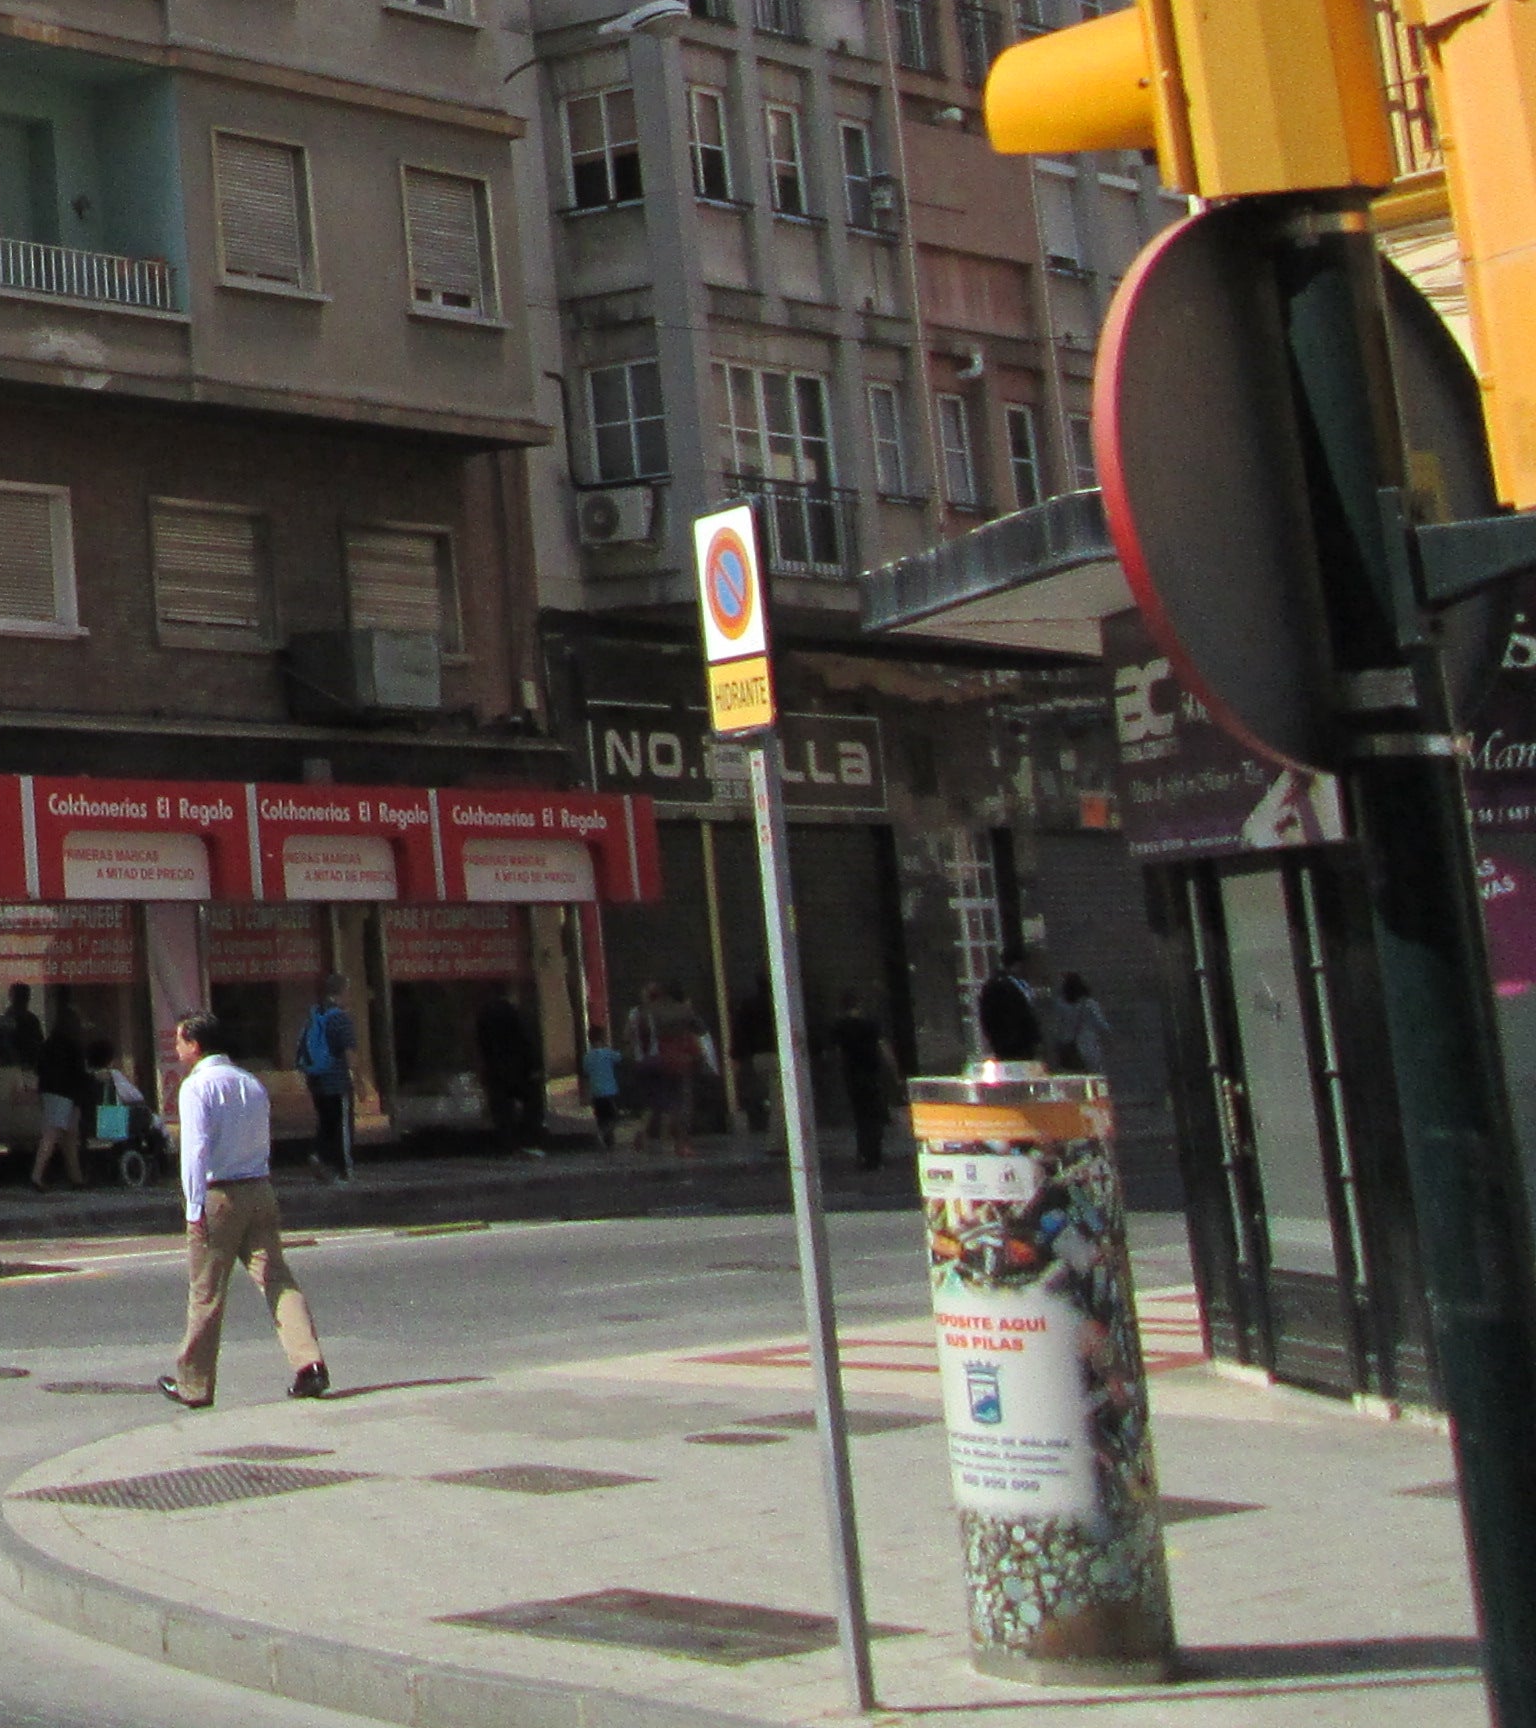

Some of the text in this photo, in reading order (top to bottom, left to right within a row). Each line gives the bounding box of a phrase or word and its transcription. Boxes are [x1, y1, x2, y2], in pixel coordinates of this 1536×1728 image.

[715, 676, 767, 712] HIDRANTE
[48, 792, 234, 826] Colchonerías El Regalo
[261, 798, 429, 830] Colchonerías El Regalo
[542, 806, 555, 828] El
[561, 808, 608, 836] Regalo
[971, 1335, 1024, 1352] PILAS
